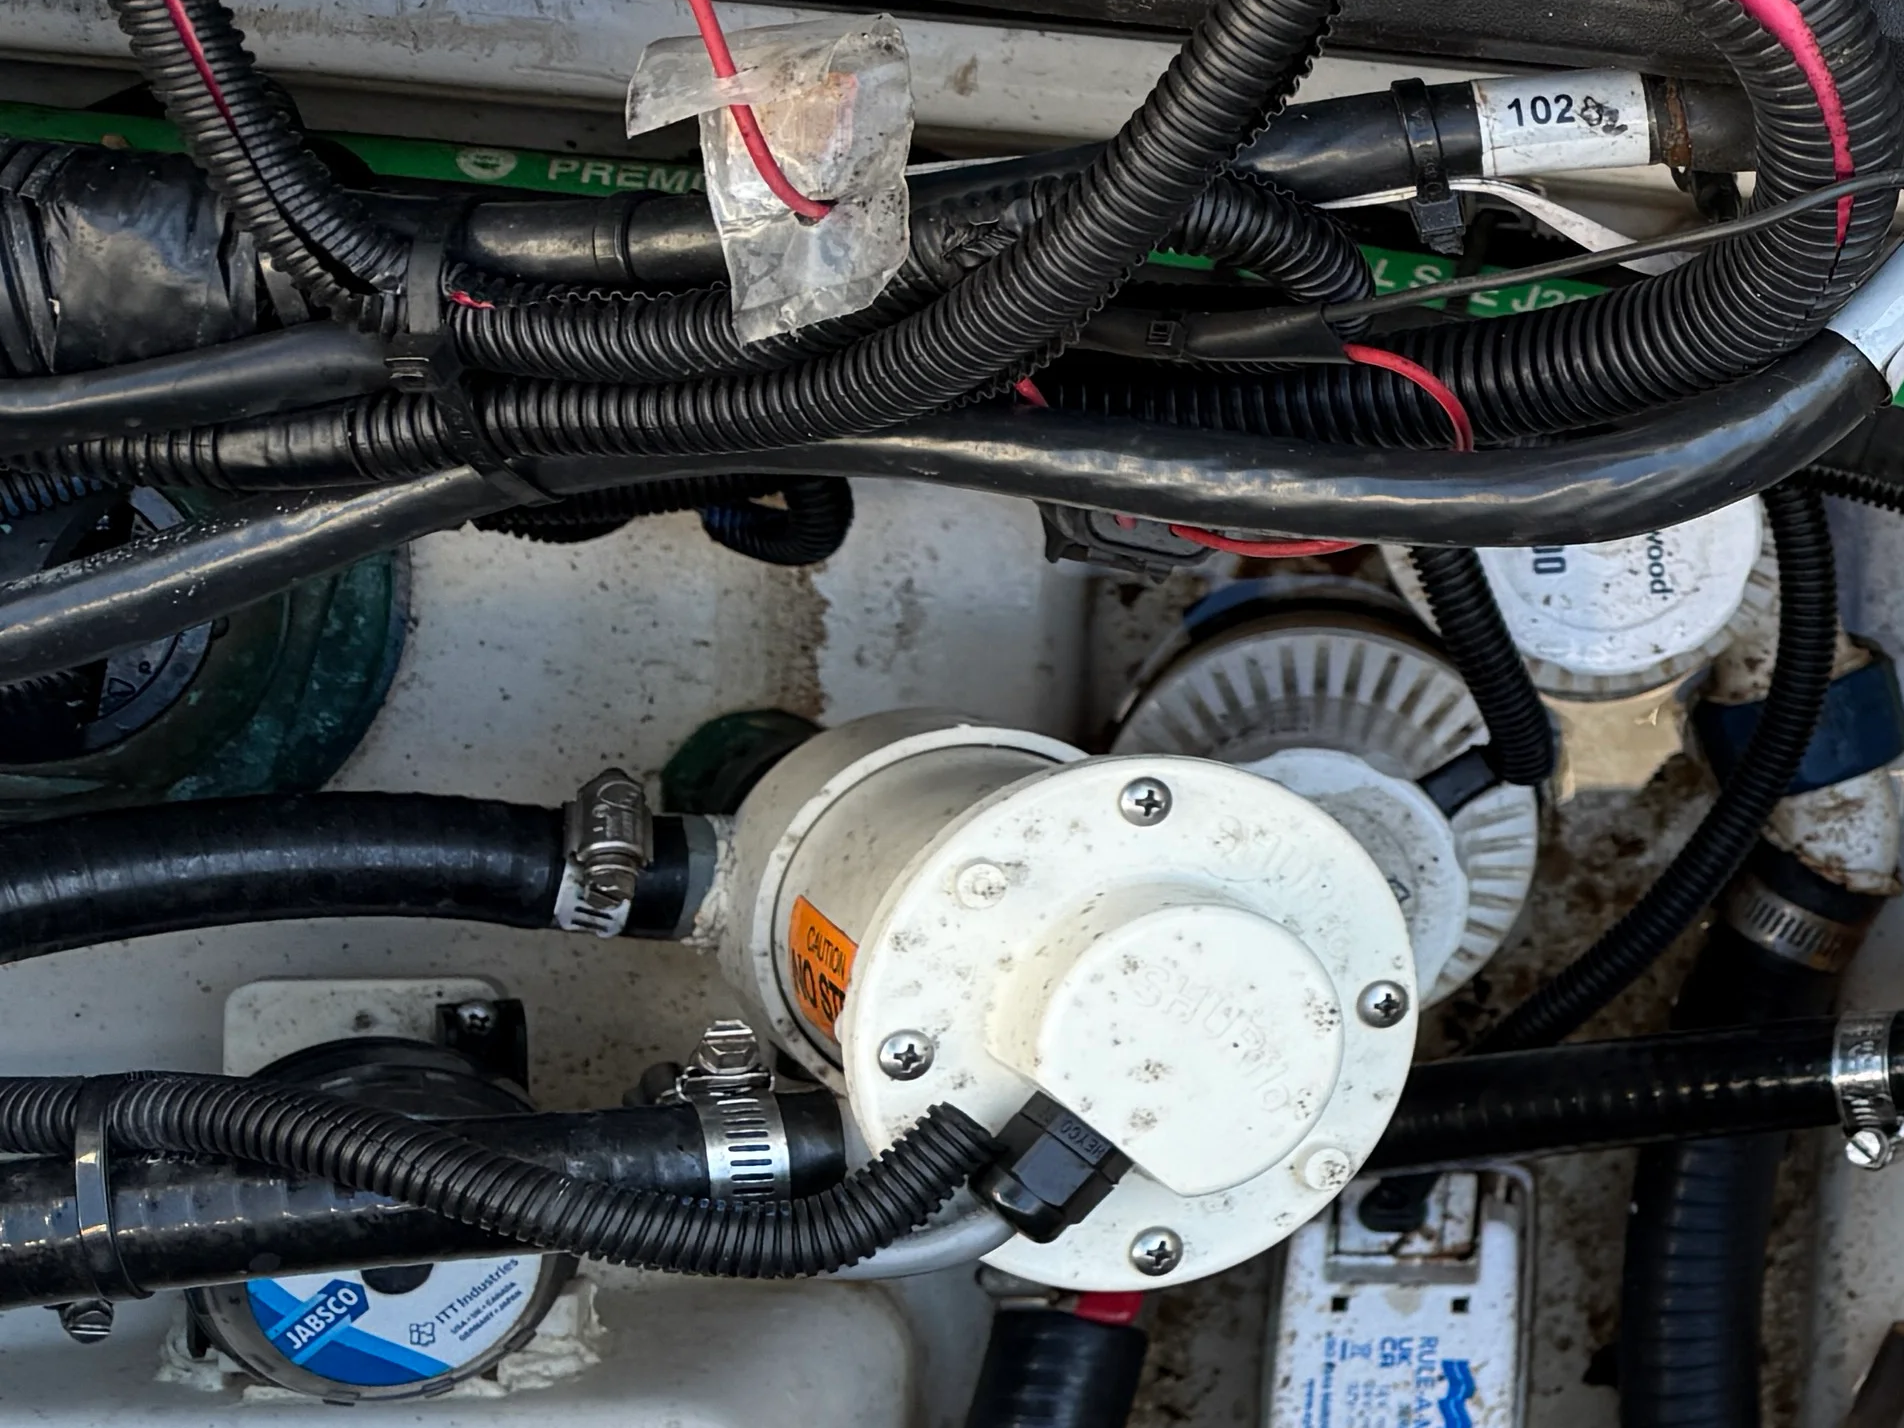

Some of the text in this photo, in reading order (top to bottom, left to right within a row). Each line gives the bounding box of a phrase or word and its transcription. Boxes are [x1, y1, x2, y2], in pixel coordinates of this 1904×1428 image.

[791, 948, 818, 1009] NO
[806, 925, 847, 981] CAUTION
[285, 1287, 359, 1350] JABSCO
[435, 1257, 520, 1326] ITT Industries
